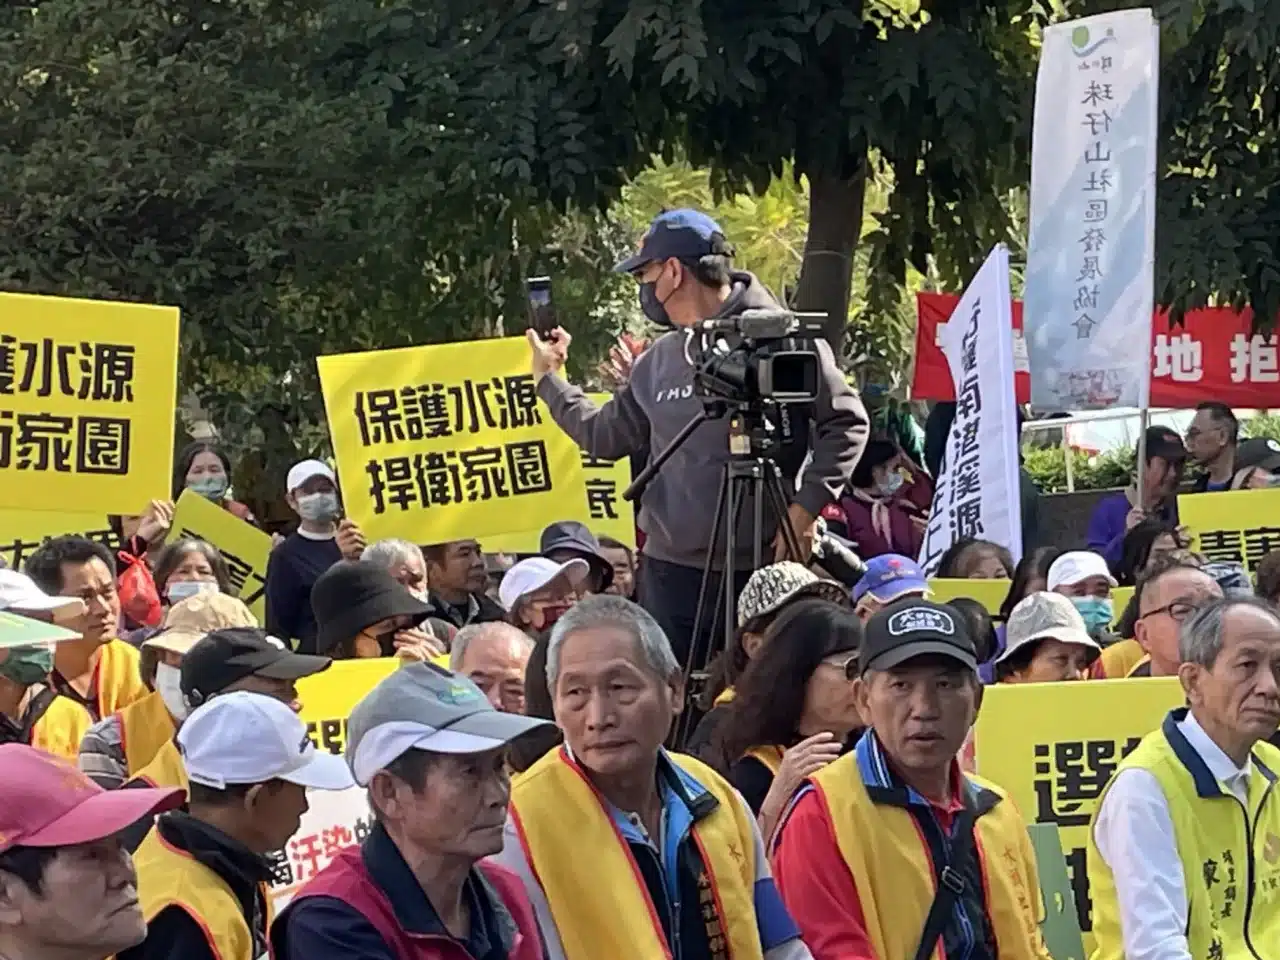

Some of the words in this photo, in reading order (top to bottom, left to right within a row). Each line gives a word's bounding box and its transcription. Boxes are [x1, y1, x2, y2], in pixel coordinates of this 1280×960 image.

[0, 411, 131, 475] 家園
[354, 374, 543, 446] 保護水源
[365, 440, 552, 514] 捍衛家園
